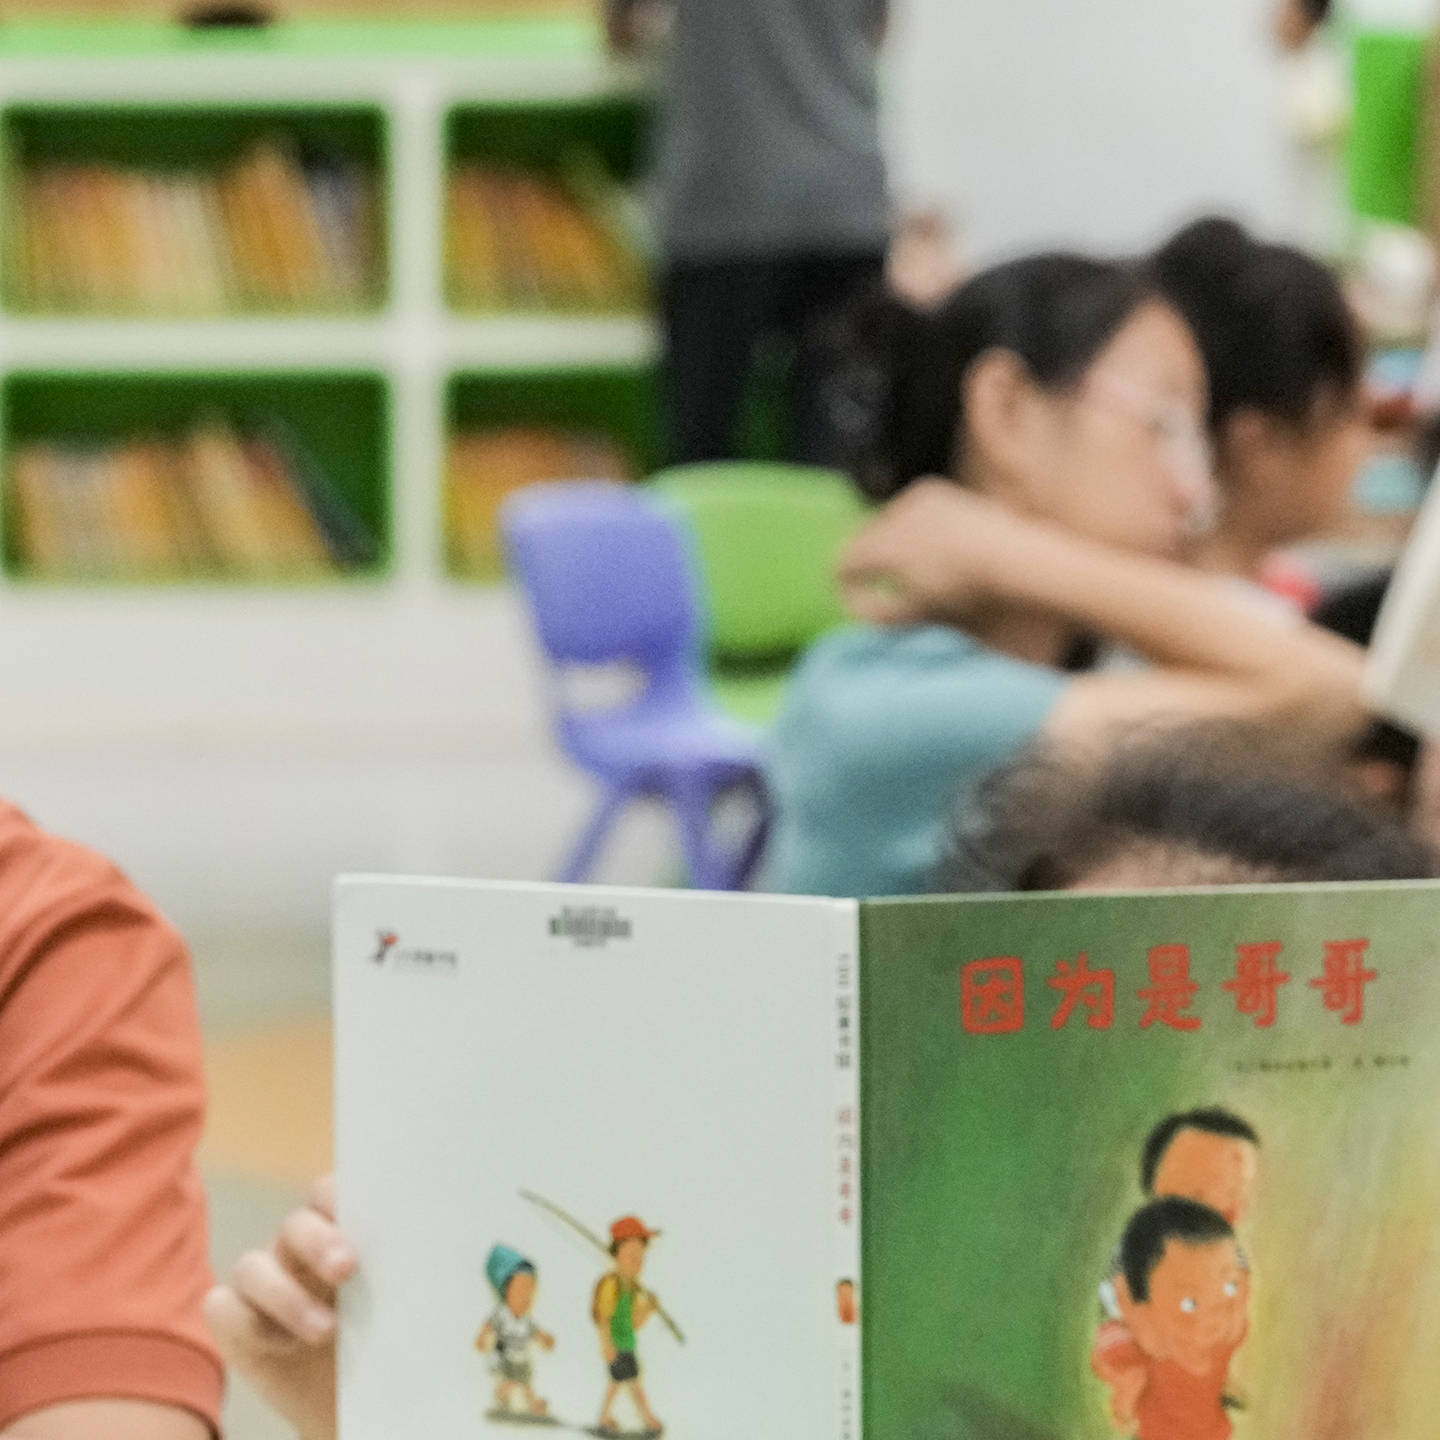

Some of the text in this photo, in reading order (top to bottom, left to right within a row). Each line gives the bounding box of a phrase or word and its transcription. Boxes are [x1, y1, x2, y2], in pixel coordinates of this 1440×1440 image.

[962, 938, 1378, 1034] 因为是哥哥
